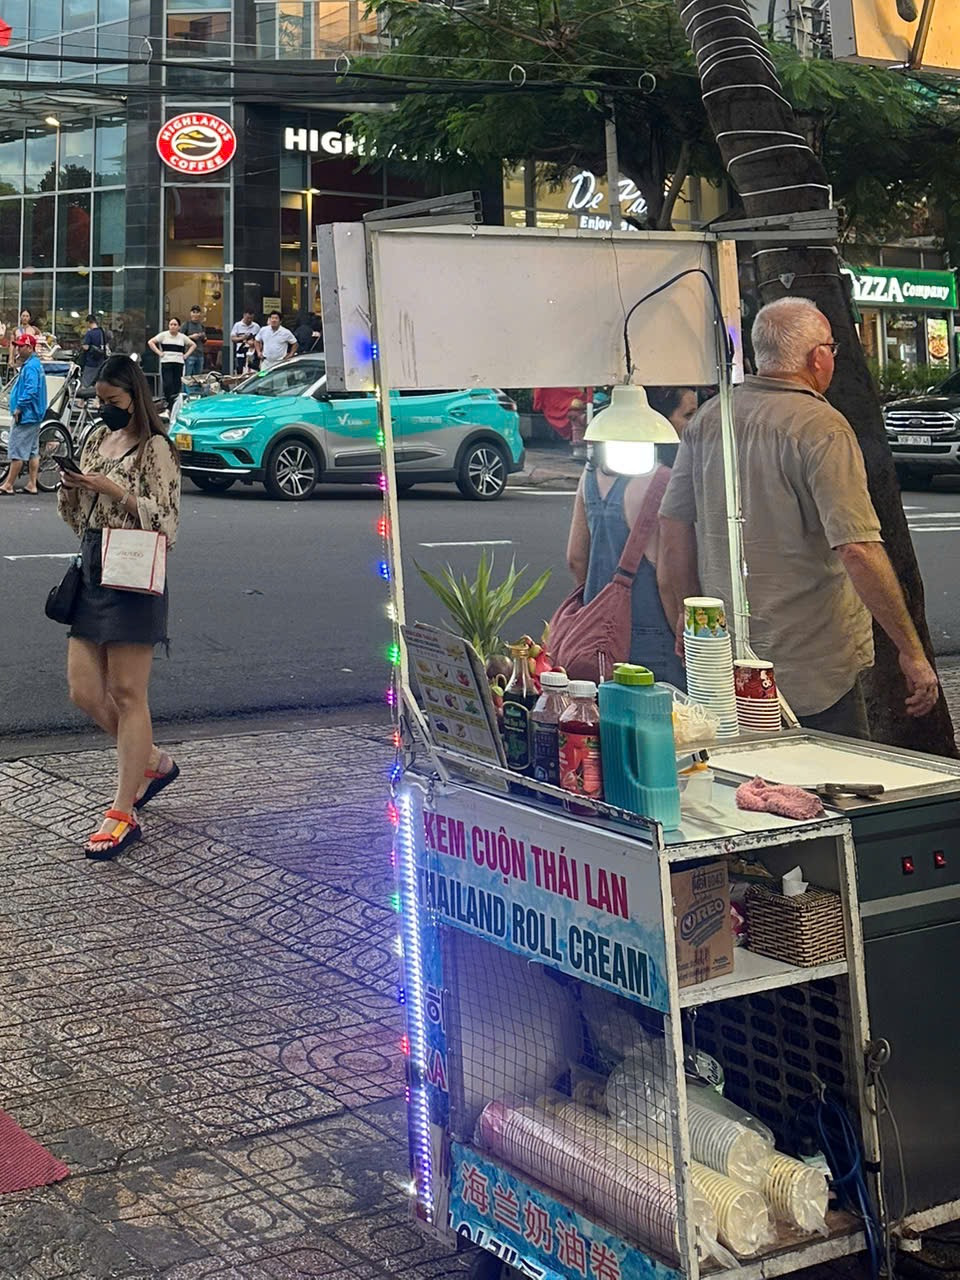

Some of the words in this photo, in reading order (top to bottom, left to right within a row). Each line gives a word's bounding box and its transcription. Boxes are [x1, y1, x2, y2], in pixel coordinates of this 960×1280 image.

[160, 115, 231, 142] HIGHLANDS
[169, 155, 225, 170] COFFEE
[580, 216, 612, 231] Enjoy
[902, 282, 949, 300] Company
[423, 810, 466, 860] KEM
[472, 826, 527, 884] CUỘN
[531, 845, 579, 901] THÁI
[584, 863, 629, 920] LAN
[681, 898, 724, 937] OREO
[512, 902, 562, 962] ROLL
[568, 925, 651, 999] CREAM
